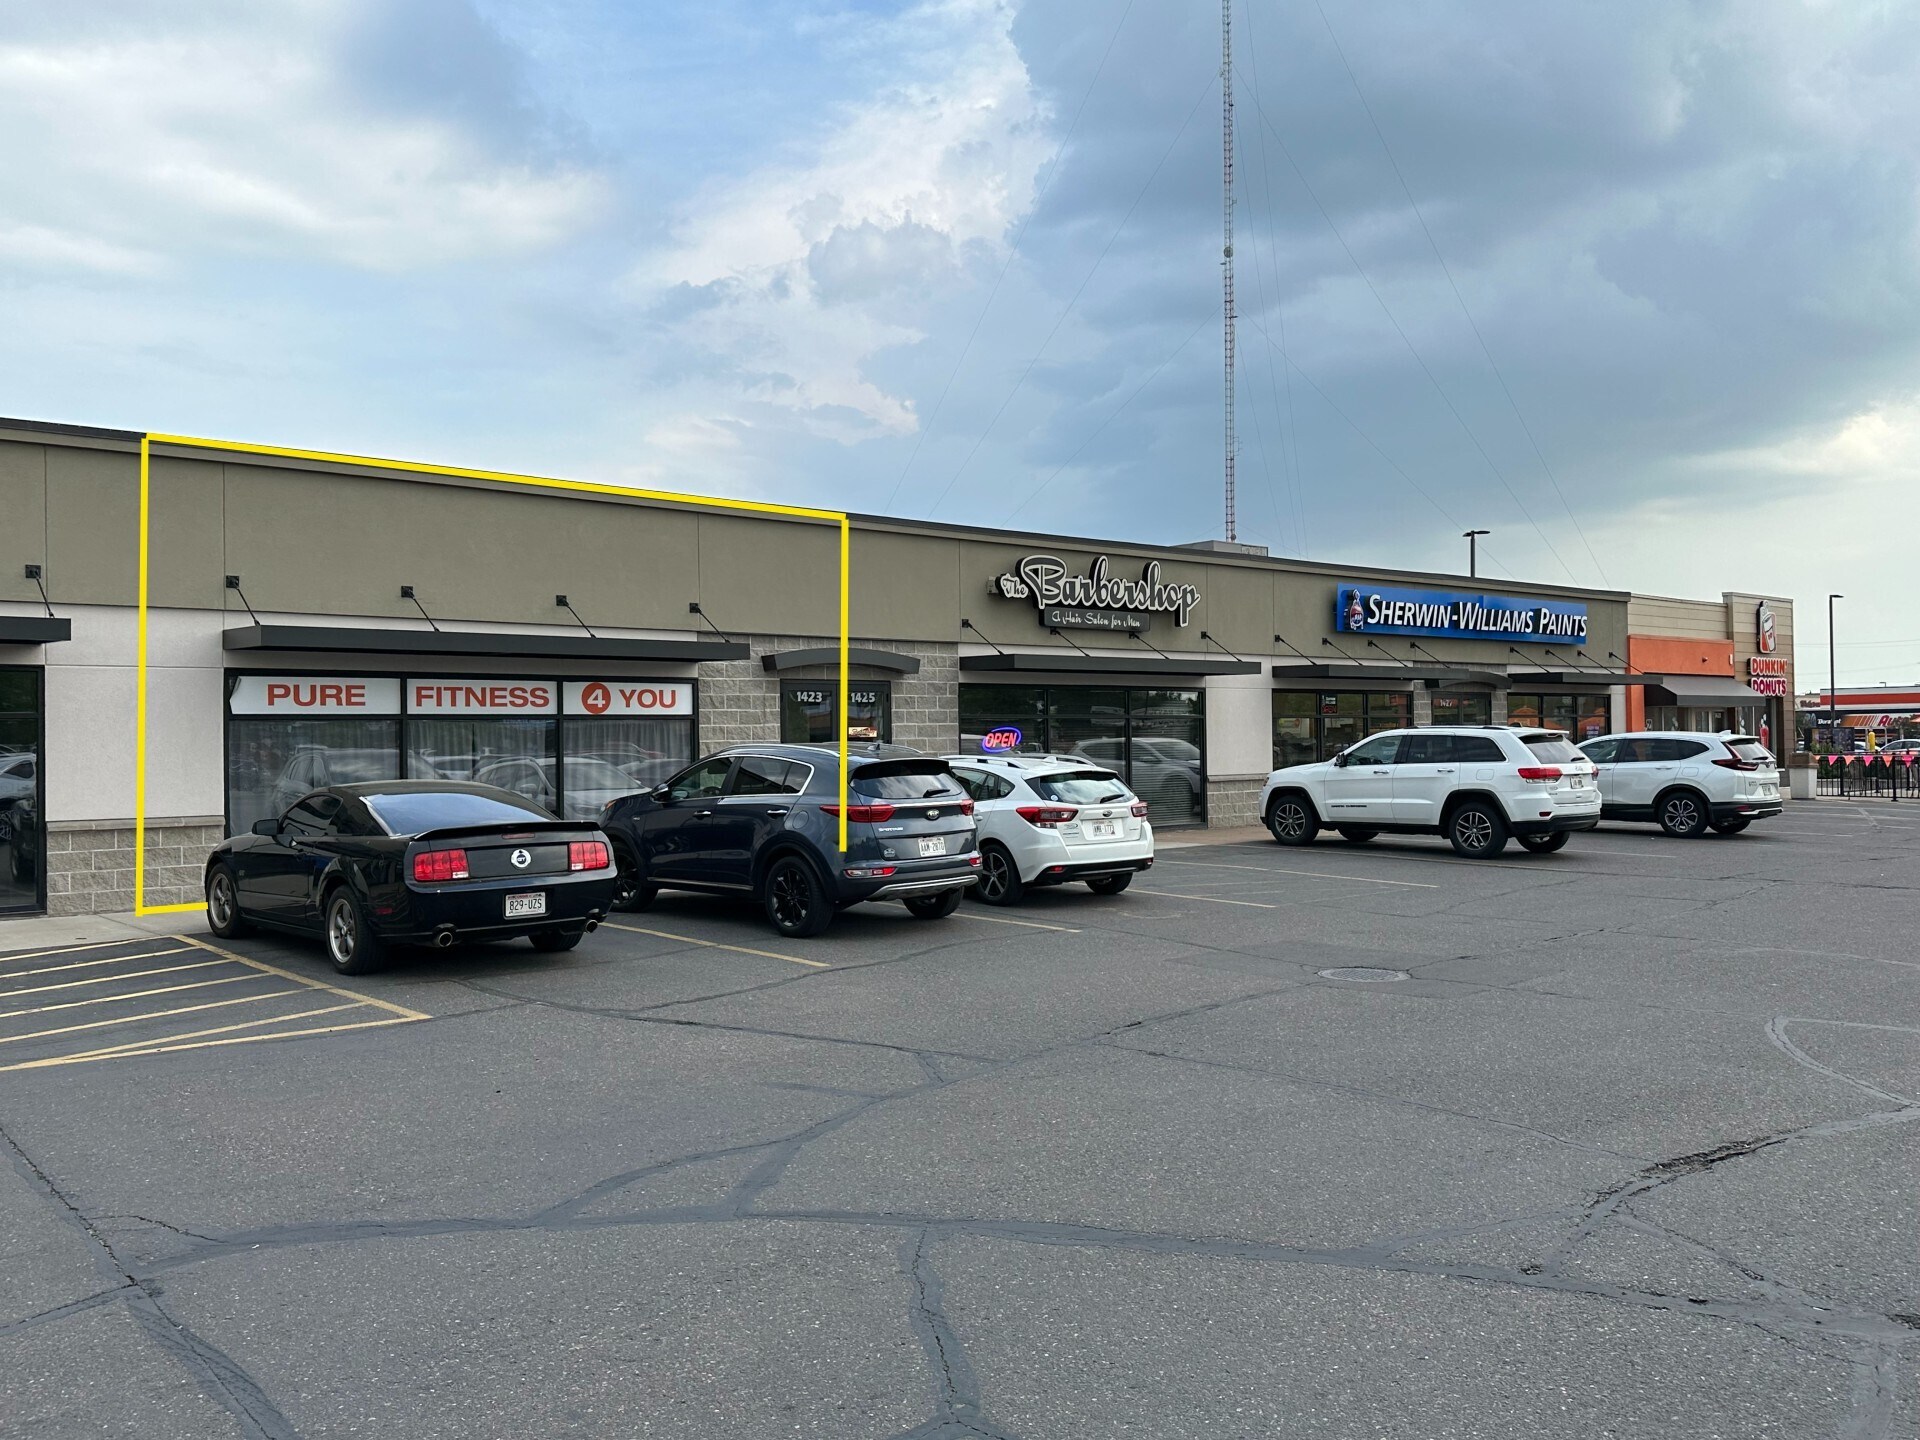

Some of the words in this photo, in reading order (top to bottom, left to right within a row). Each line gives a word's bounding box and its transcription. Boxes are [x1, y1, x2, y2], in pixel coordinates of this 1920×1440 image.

[1001, 574, 1028, 598] The
[1020, 555, 1200, 627] Barbershop
[1052, 610, 1061, 622] A
[1063, 611, 1081, 624] Hair
[1084, 612, 1109, 624] Salon
[1111, 614, 1121, 628] for
[1123, 614, 1141, 627] Men
[1367, 594, 1533, 633] SHERWIN-WILLIAMS
[1539, 607, 1588, 637] PAINTS
[1751, 657, 1787, 675] DUNKIN'
[267, 684, 366, 707] PURE
[415, 686, 550, 708] FITNESS
[619, 689, 676, 708] YOU
[1752, 678, 1787, 696] DONUTS
[796, 691, 823, 703] 1423
[850, 692, 876, 703] 1425
[985, 732, 1018, 748] OPEN
[509, 898, 542, 911] 829-UZS
